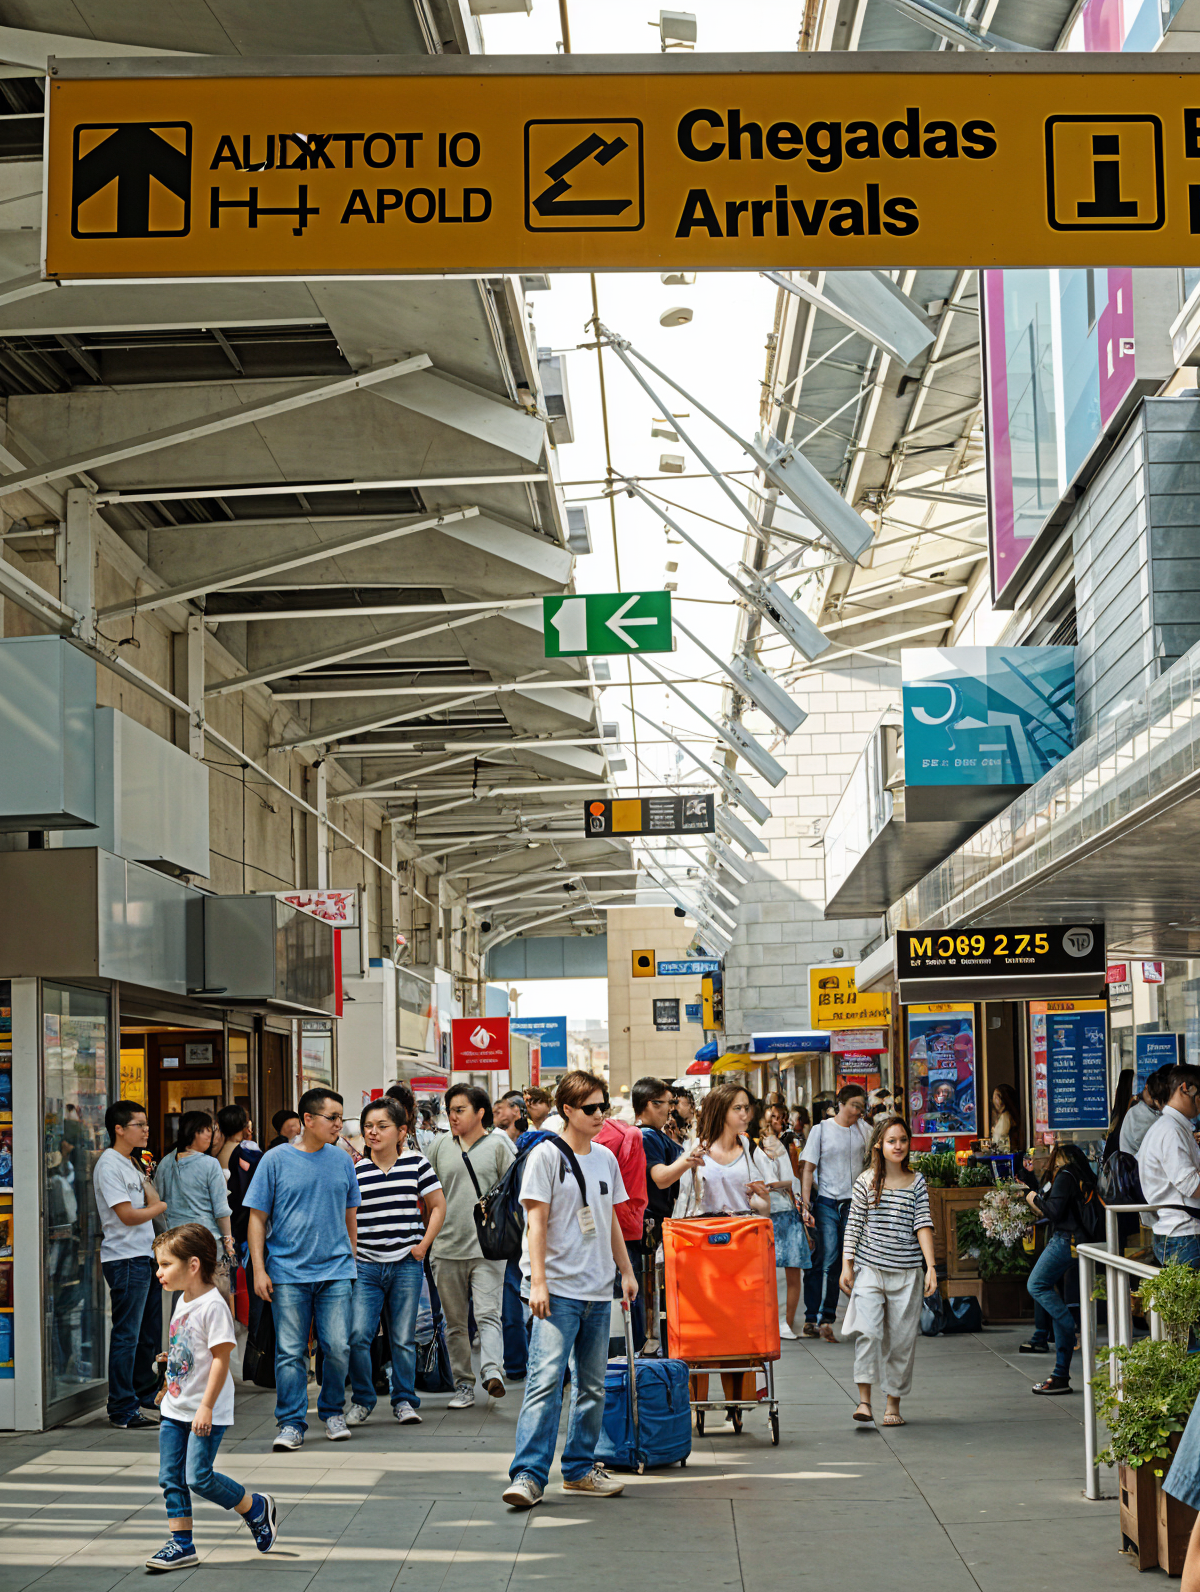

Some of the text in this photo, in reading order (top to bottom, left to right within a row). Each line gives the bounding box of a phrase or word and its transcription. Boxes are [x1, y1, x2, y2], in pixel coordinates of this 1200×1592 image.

[677, 107, 997, 173] Chegadas
[340, 187, 492, 224] APOLD
[675, 183, 920, 238] Arrivals
